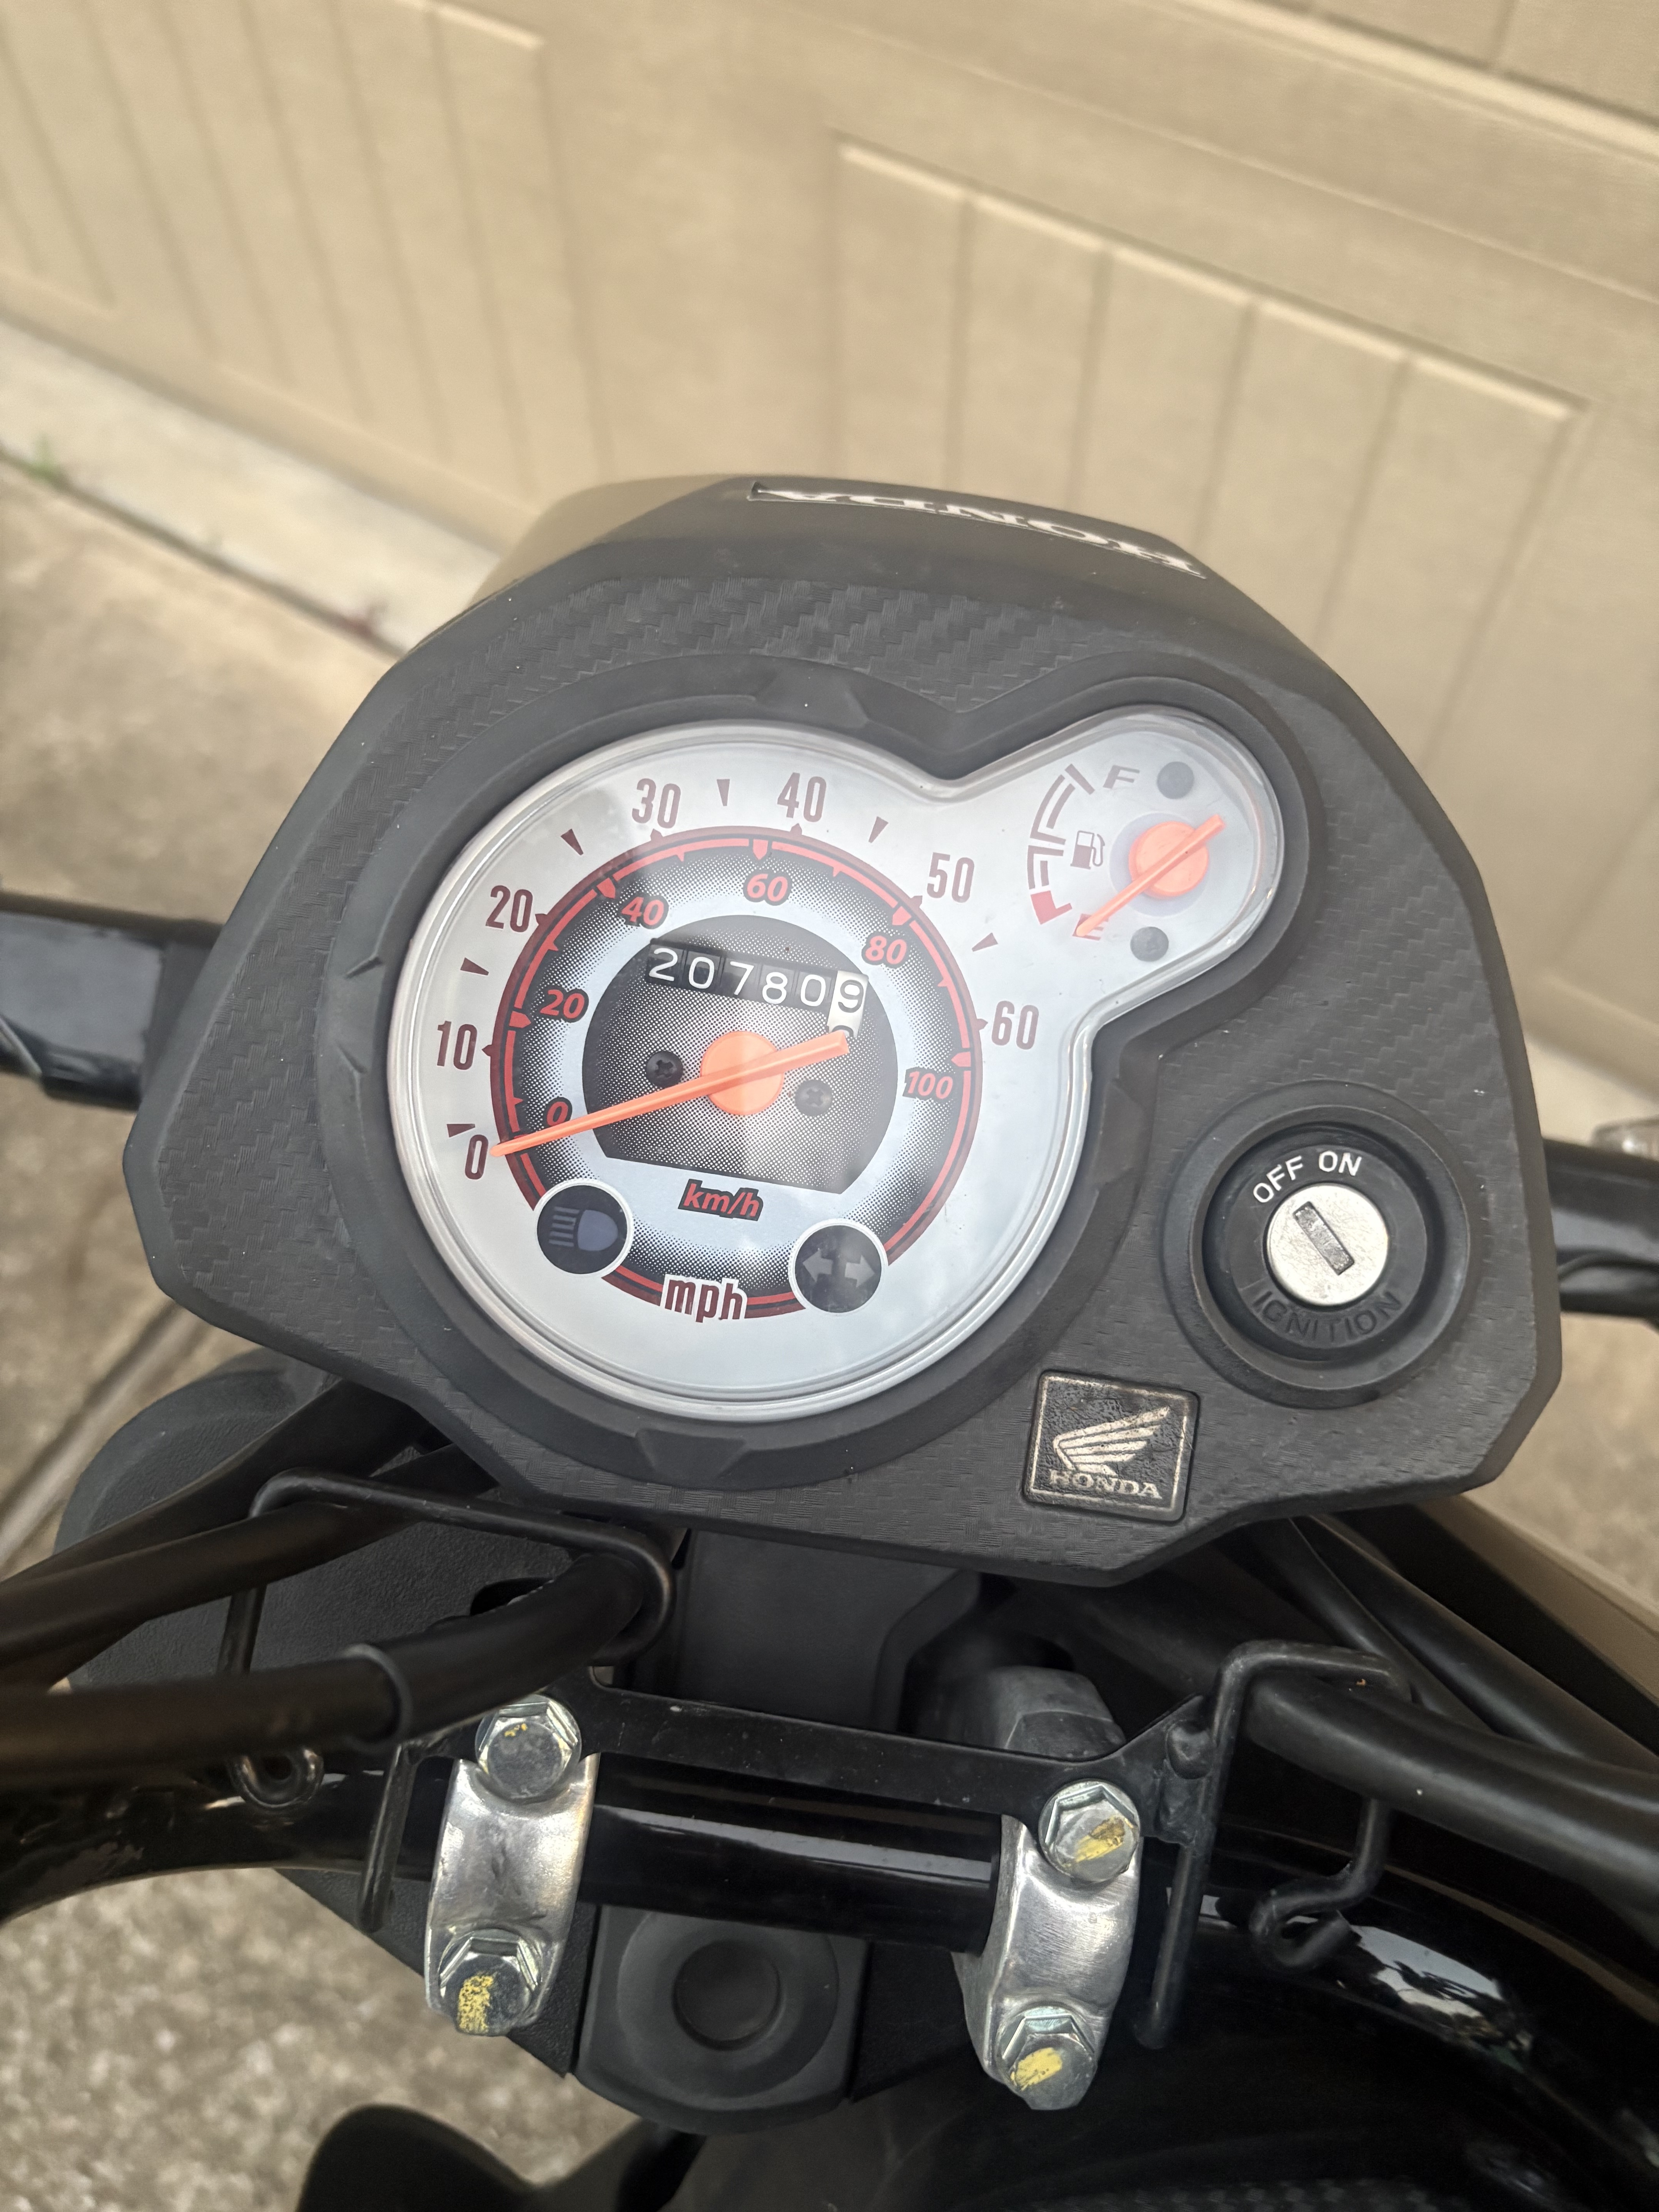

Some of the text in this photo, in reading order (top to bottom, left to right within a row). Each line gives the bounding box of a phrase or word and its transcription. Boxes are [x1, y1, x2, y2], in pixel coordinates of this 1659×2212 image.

[757, 489, 1202, 575] HONDA
[777, 773, 826, 822] 40
[1103, 765, 1140, 789] F
[632, 778, 681, 828] 30
[747, 873, 788, 902] 60
[927, 852, 975, 903] 50
[485, 885, 533, 933] 20
[622, 896, 665, 926] 40
[865, 936, 907, 965] 80
[649, 947, 864, 1013] 207809
[540, 989, 585, 1018] 20
[991, 1001, 1039, 1050] 60
[436, 1020, 477, 1070] 10
[907, 1071, 953, 1099] 100
[546, 1101, 568, 1127] 0
[465, 1135, 488, 1180] 0
[1253, 1156, 1304, 1203] OFF
[1318, 1151, 1362, 1176] ON
[683, 1183, 759, 1217] km/h
[665, 1279, 743, 1323] mph
[1252, 1290, 1403, 1342] IGNITION
[1049, 1469, 1163, 1499] HONDA
